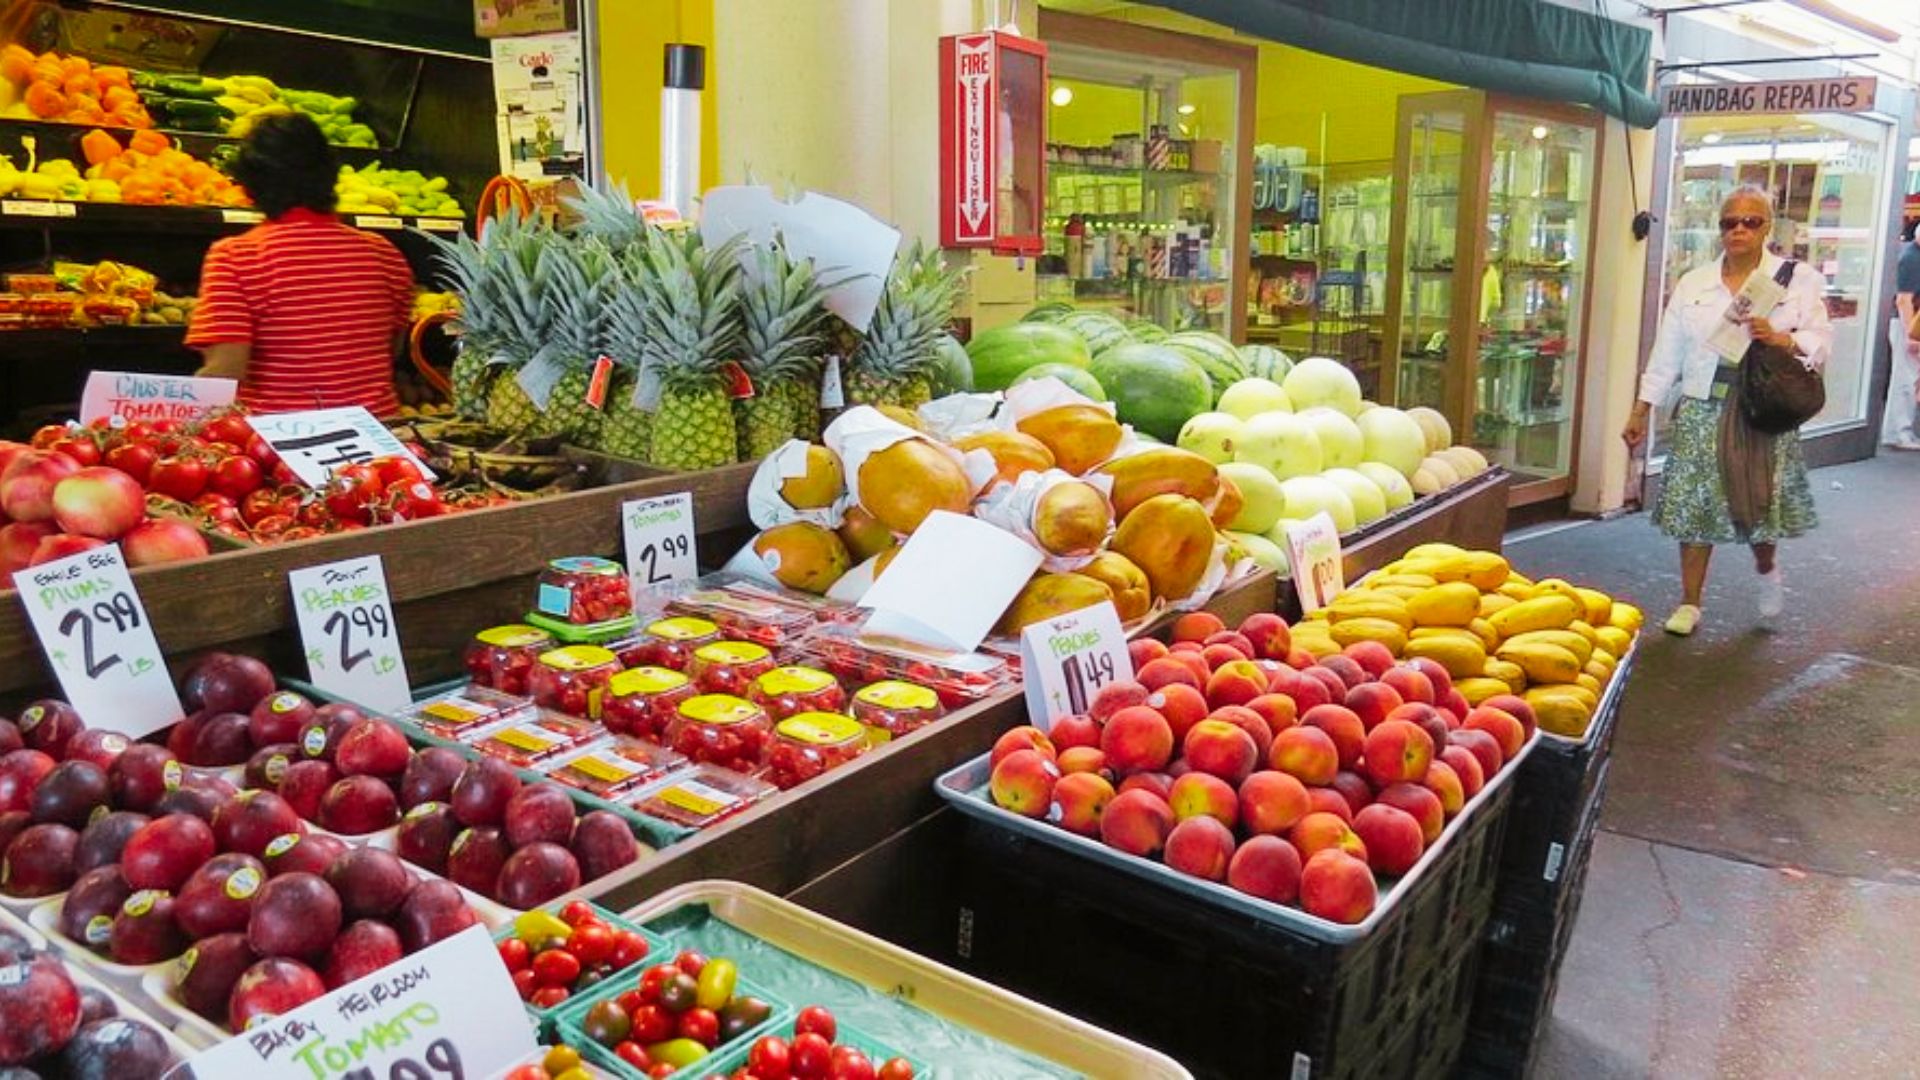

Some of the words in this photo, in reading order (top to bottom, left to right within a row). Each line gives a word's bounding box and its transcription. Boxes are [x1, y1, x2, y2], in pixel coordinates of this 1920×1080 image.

[961, 52, 989, 76] FIRE
[1668, 86, 1755, 112] HANDBAG
[1764, 82, 1859, 110] REPAIRS
[969, 77, 980, 221] EXTINGUISHER
[249, 1018, 325, 1060] BABY
[337, 965, 431, 1021] HEIRLOOM
[291, 1001, 440, 1080] TOMATO
